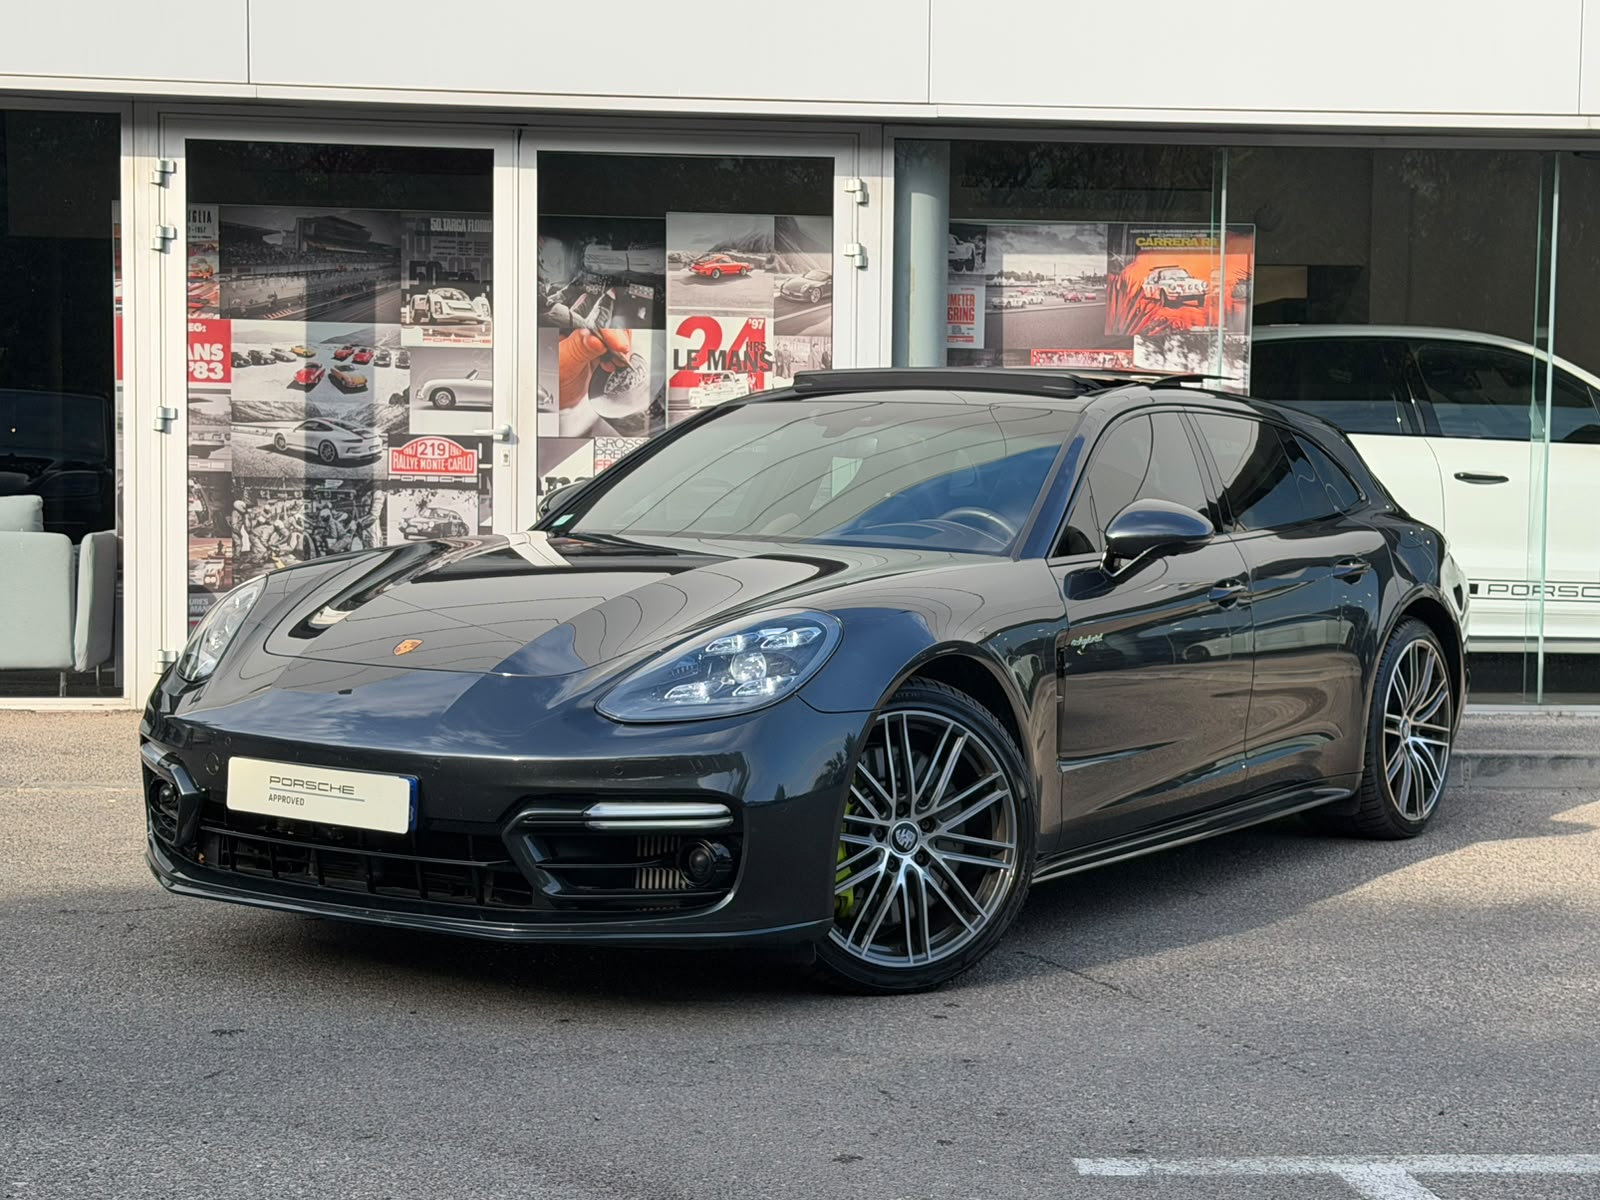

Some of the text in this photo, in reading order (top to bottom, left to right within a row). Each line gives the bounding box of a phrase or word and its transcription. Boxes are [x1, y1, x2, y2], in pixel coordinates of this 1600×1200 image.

[1135, 237, 1199, 247] CARRERA
[748, 319, 765, 329] '97
[746, 341, 767, 352] HRS
[673, 349, 774, 373] LE MANS
[418, 441, 446, 457] 219
[392, 451, 473, 472] RALLYE MONTE-CARLO
[388, 474, 478, 483] PORSCHE
[269, 775, 355, 795] PORSCHE
[268, 793, 305, 807] APPROVED
